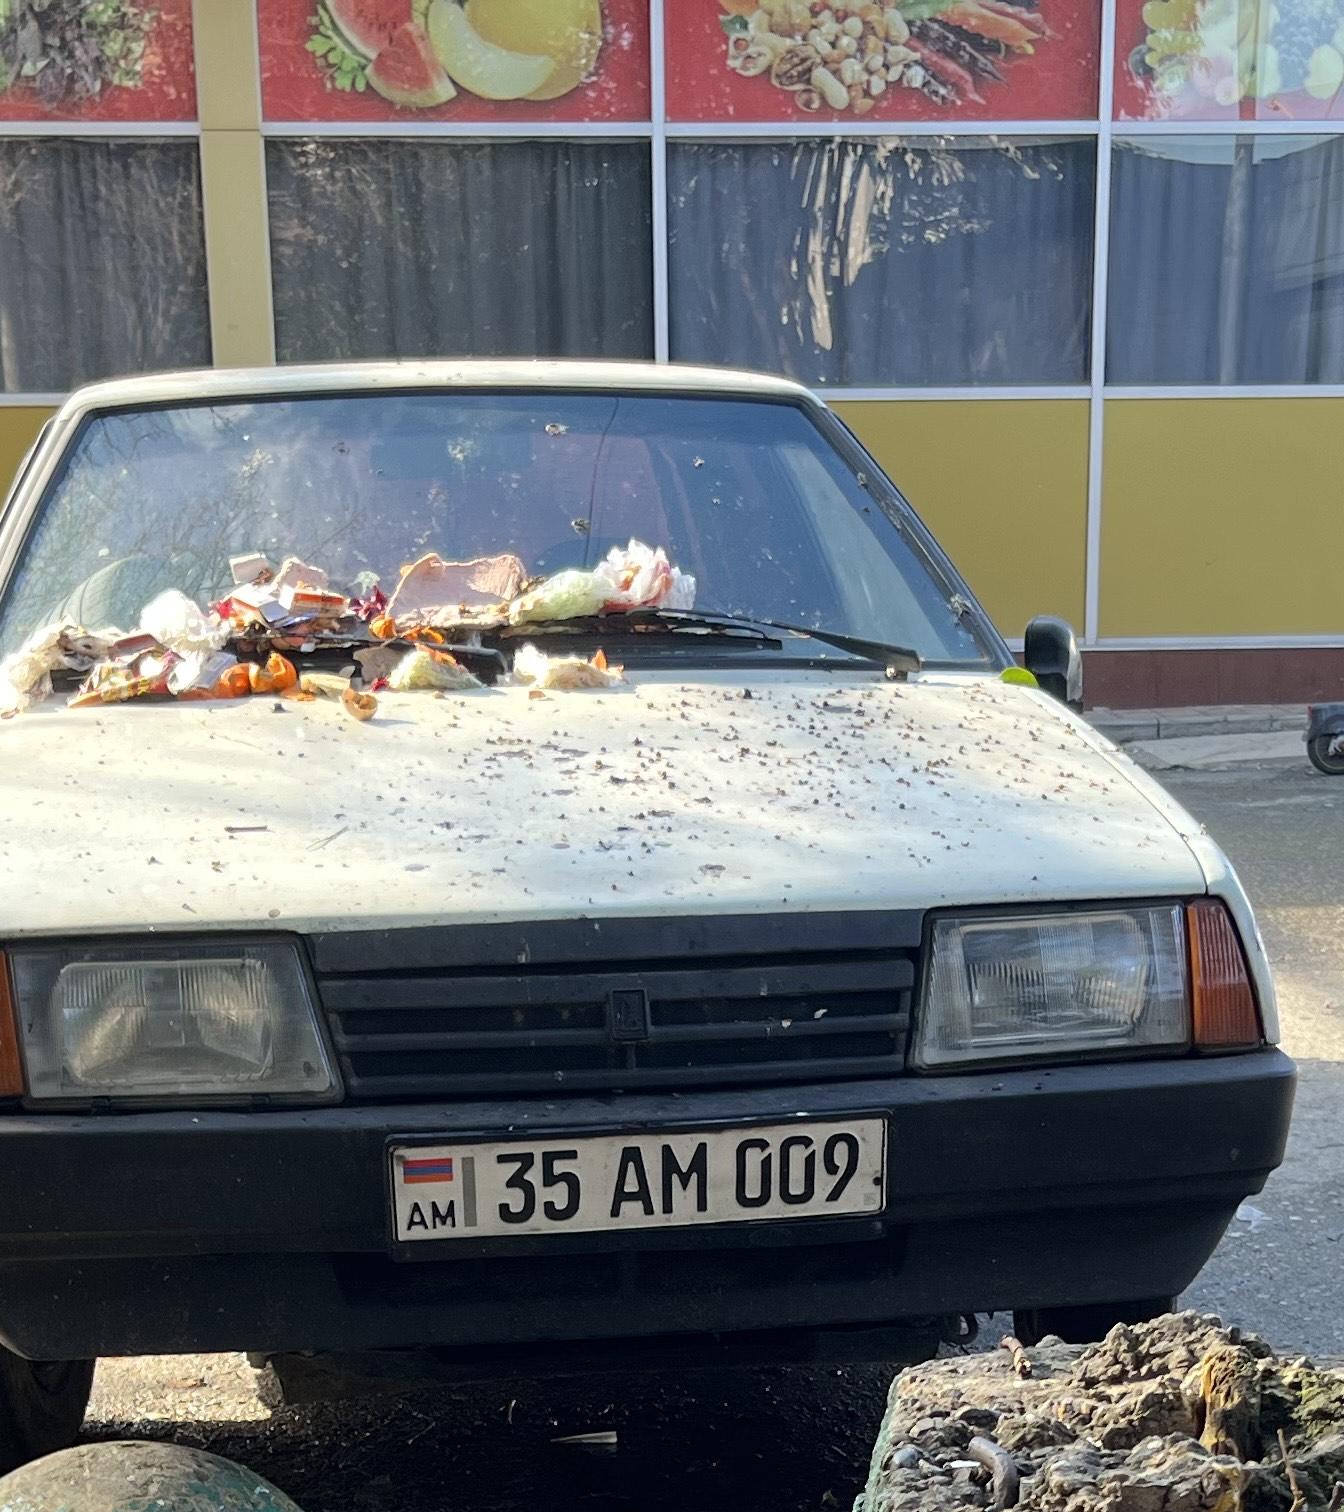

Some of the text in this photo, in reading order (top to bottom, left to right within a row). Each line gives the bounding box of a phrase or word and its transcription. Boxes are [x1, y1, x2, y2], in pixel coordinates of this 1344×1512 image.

[496, 1132, 860, 1223] 35 AM 009
[405, 1199, 456, 1231] AM
